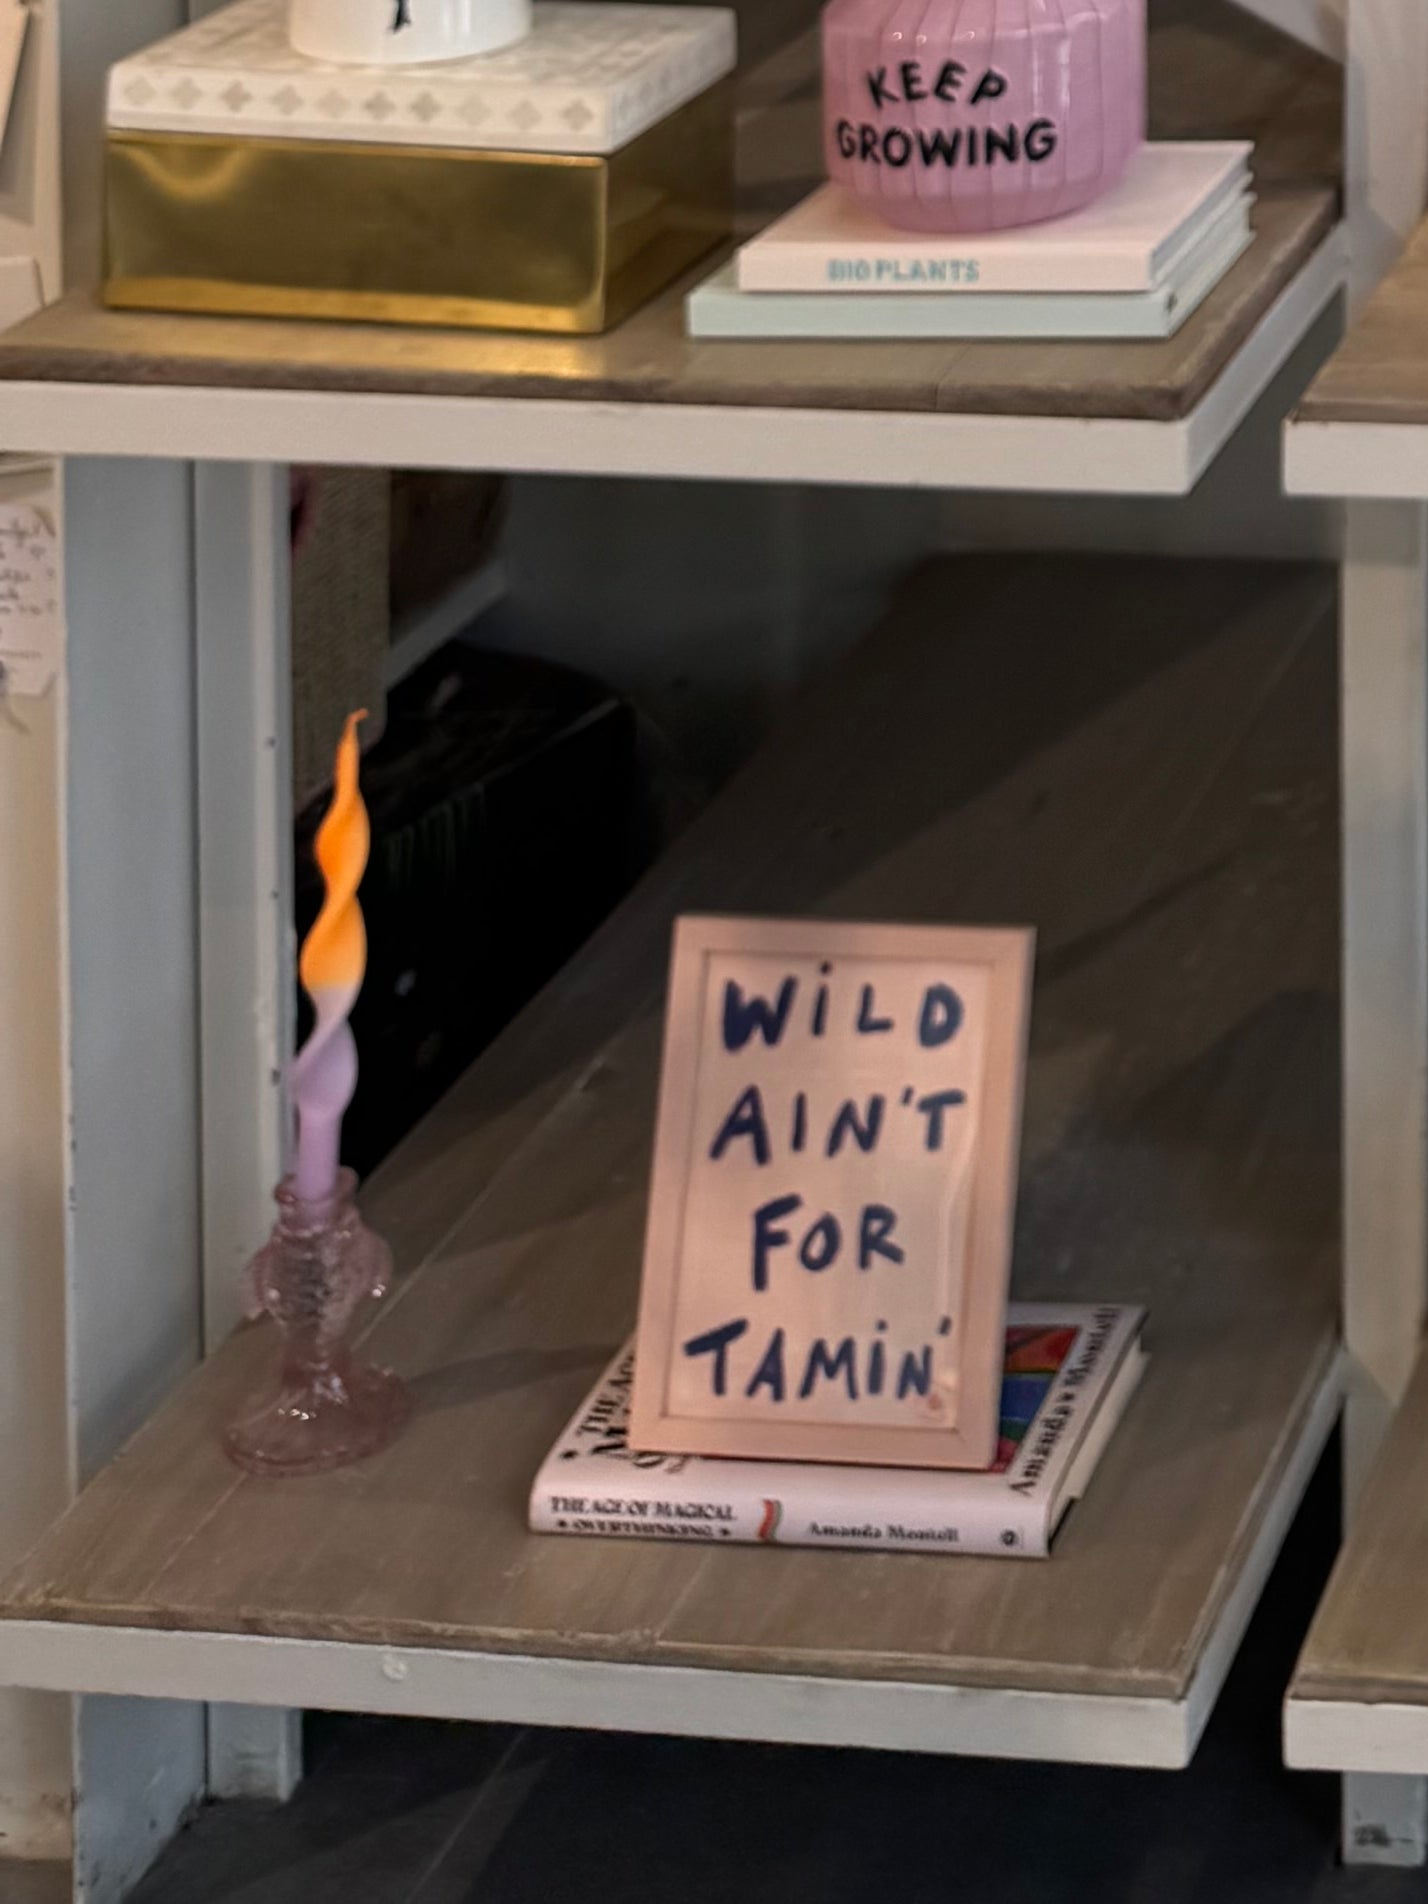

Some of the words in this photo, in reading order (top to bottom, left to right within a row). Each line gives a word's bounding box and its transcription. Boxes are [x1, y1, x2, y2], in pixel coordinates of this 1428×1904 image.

[866, 59, 1007, 109] KEEP
[835, 118, 1058, 168] GROWING
[875, 257, 980, 283] PLANTS
[710, 1084, 967, 1166] AIN'T
[751, 1194, 905, 1292] FOR
[550, 1497, 590, 1514] THE
[591, 1497, 623, 1516] AGE
[626, 1498, 649, 1517] OF
[654, 1499, 738, 1521] MAGICAL
[571, 1518, 714, 1538] OVERTHINKING
[806, 1520, 883, 1541] Amanda
